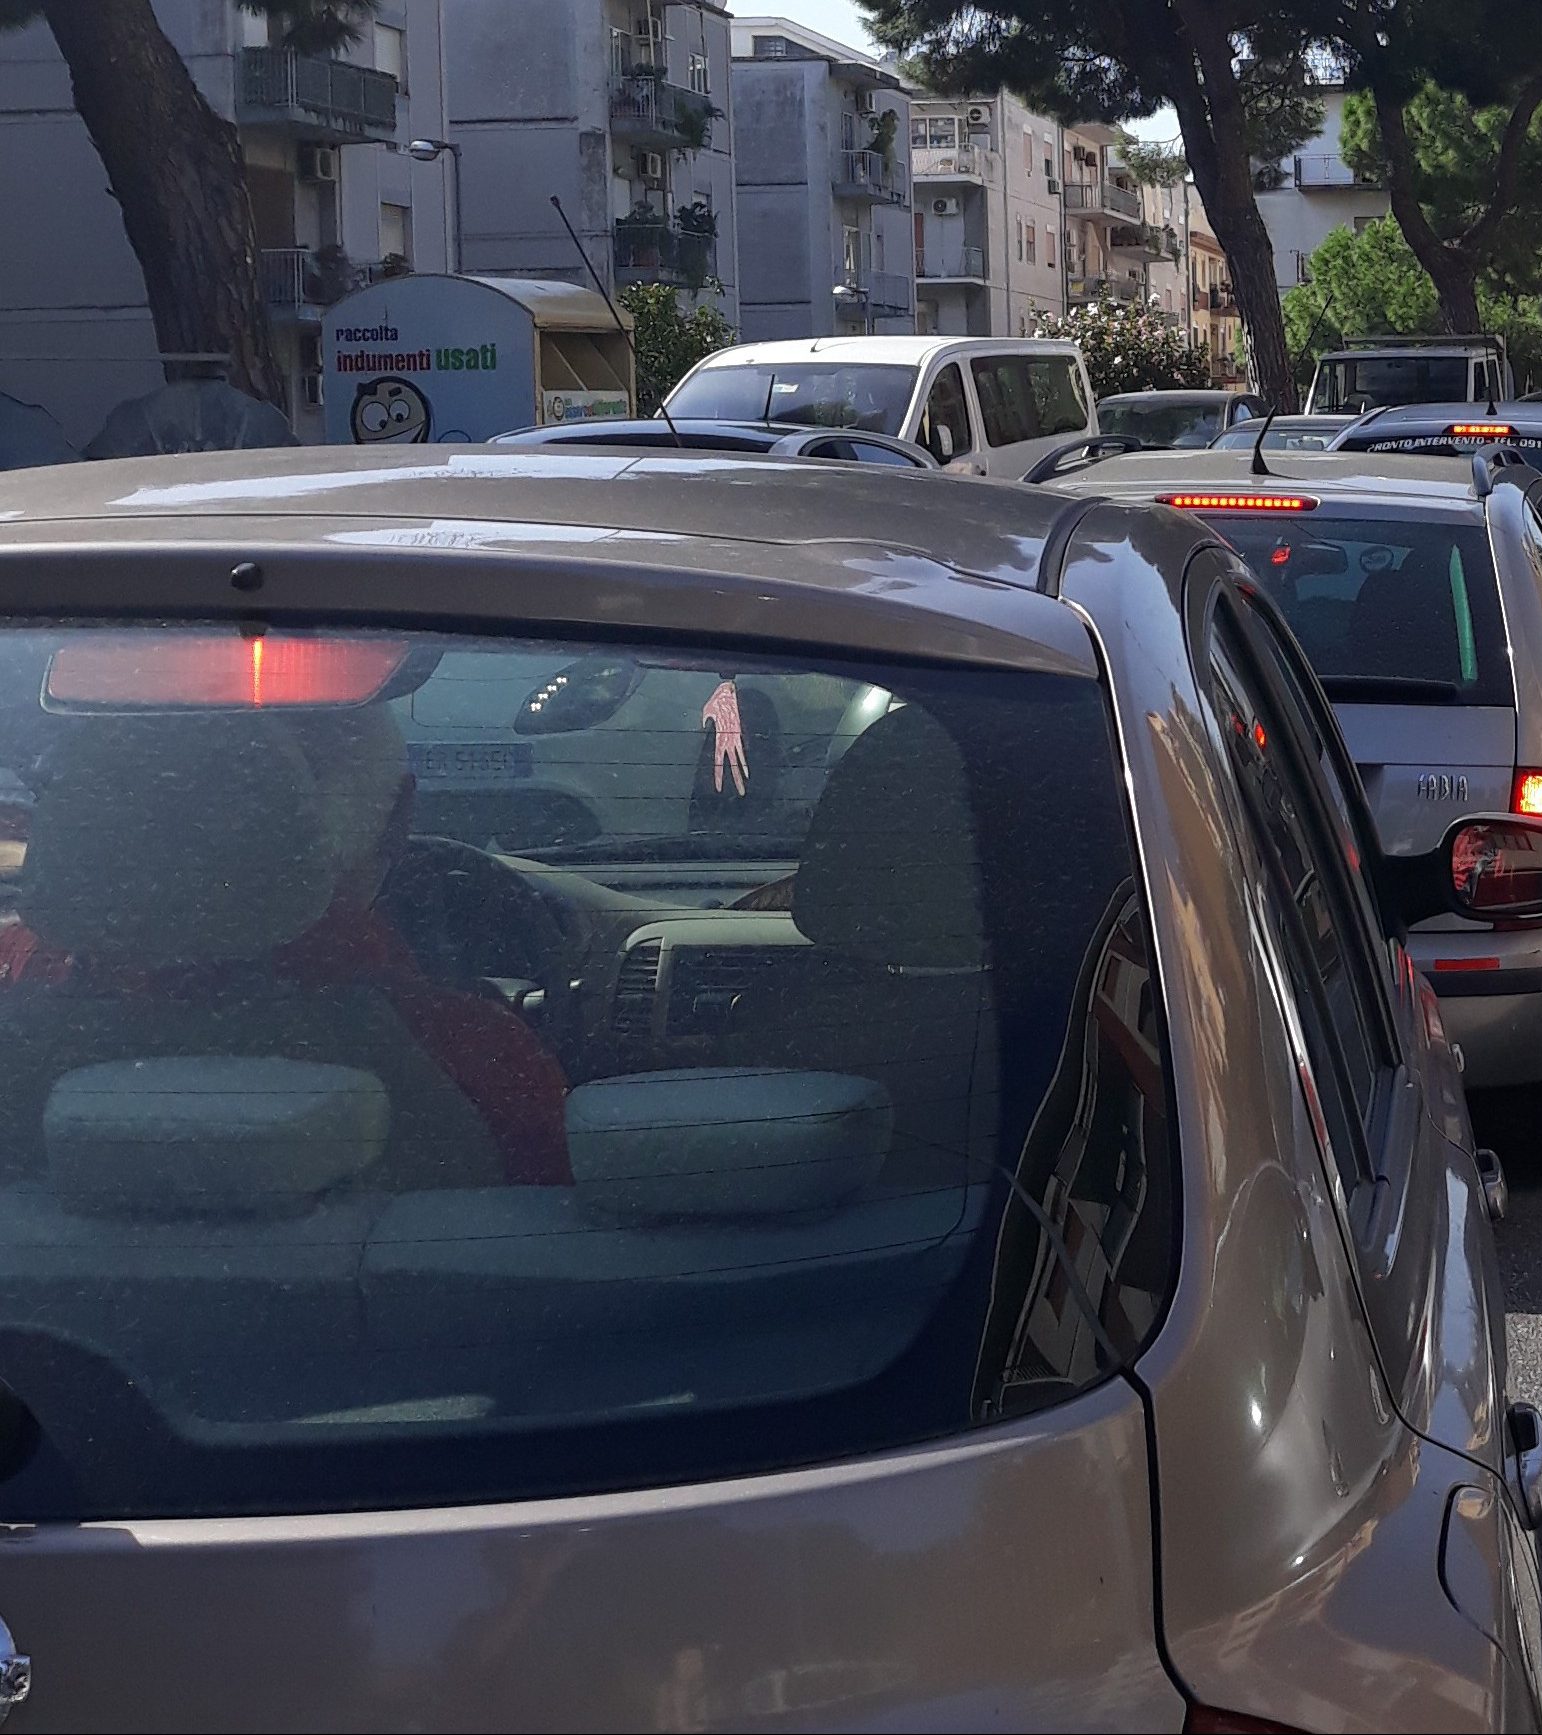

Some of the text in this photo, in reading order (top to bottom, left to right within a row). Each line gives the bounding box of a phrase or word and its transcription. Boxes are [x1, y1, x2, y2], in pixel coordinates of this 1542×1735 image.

[335, 325, 399, 342] raccolta
[336, 343, 497, 372] indumenti usati
[1414, 436, 1485, 447] INTERVENTO
